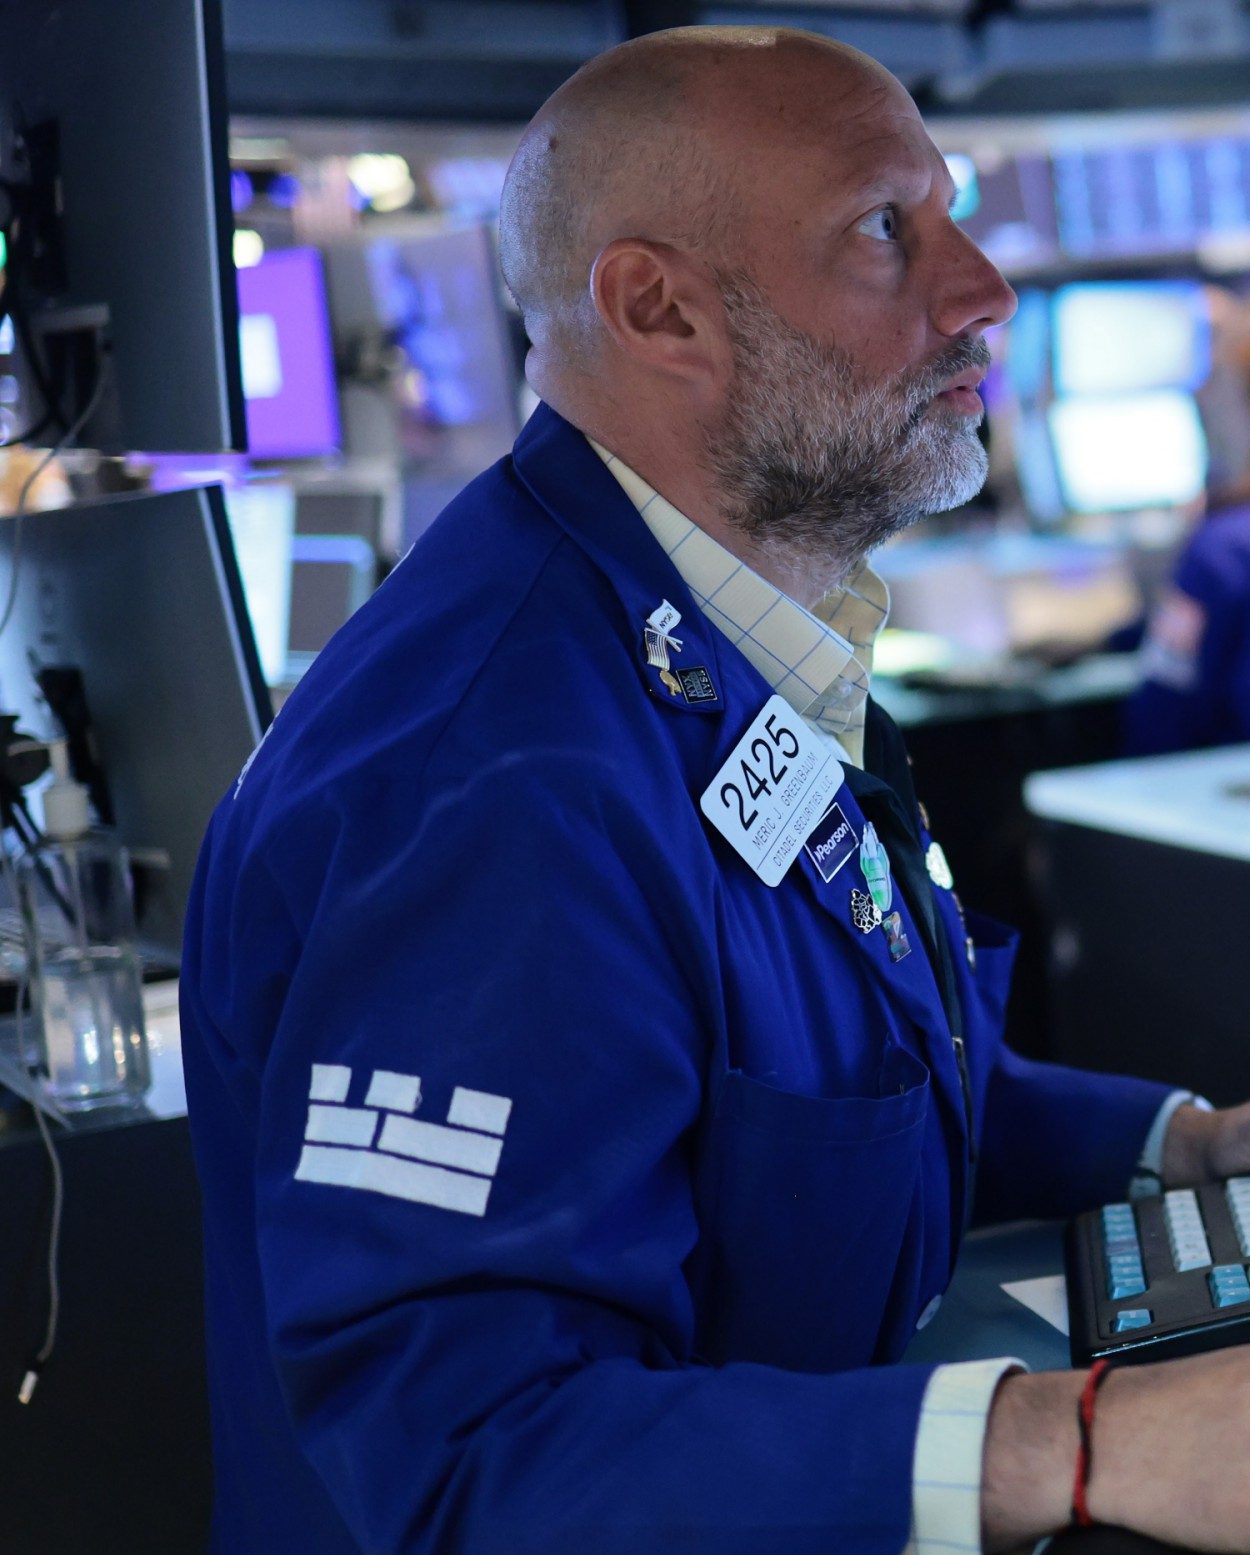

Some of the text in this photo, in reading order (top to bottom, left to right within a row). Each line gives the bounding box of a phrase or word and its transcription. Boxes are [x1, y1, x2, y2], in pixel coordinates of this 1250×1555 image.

[720, 714, 799, 831] 2425
[752, 817, 777, 851] MERIC
[780, 752, 819, 807] GREENBAUM
[772, 775, 834, 867] CITADEL SECURITIES LLC
[817, 822, 850, 861] Pearson
